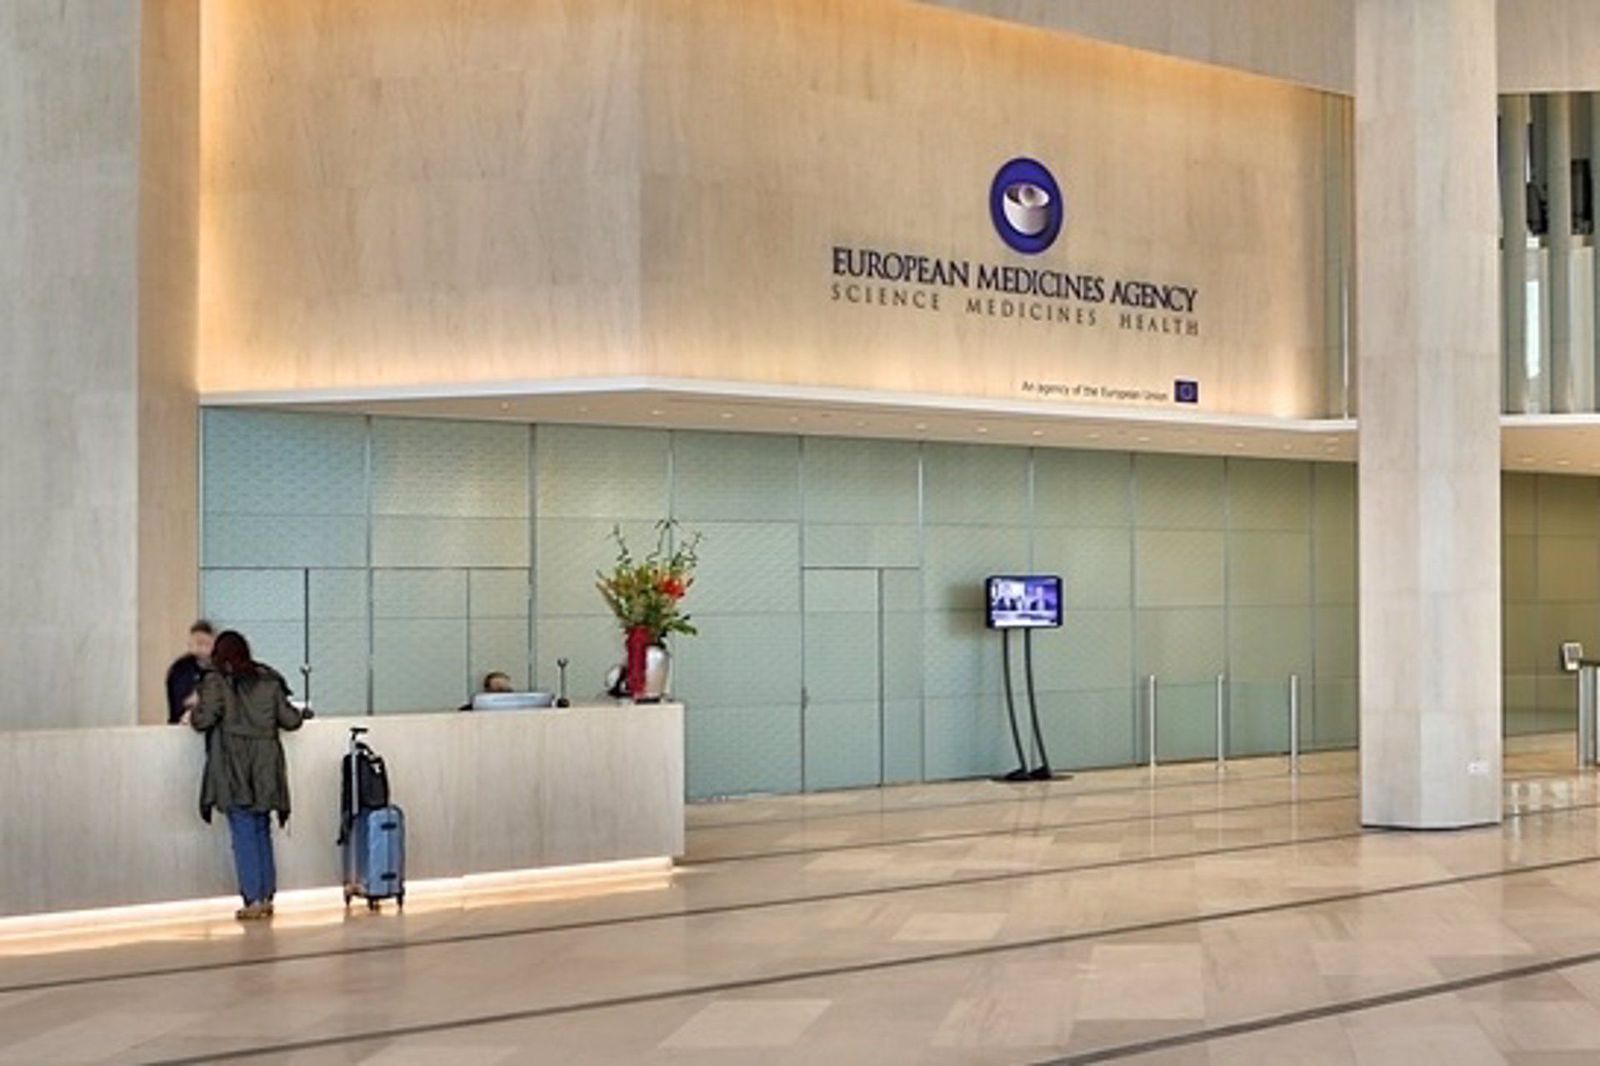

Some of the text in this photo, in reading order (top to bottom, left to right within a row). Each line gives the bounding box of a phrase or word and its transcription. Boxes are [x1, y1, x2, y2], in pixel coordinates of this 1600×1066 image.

[832, 247, 1199, 313] EUROPEAN MEDICINES AGENCY
[830, 283, 1200, 336] SCIENCE MEDICINES HEALTH
[1022, 381, 1035, 392] An
[1038, 383, 1069, 396] agency
[1072, 383, 1083, 395] of
[1084, 385, 1099, 397] the
[1101, 386, 1141, 400] European
